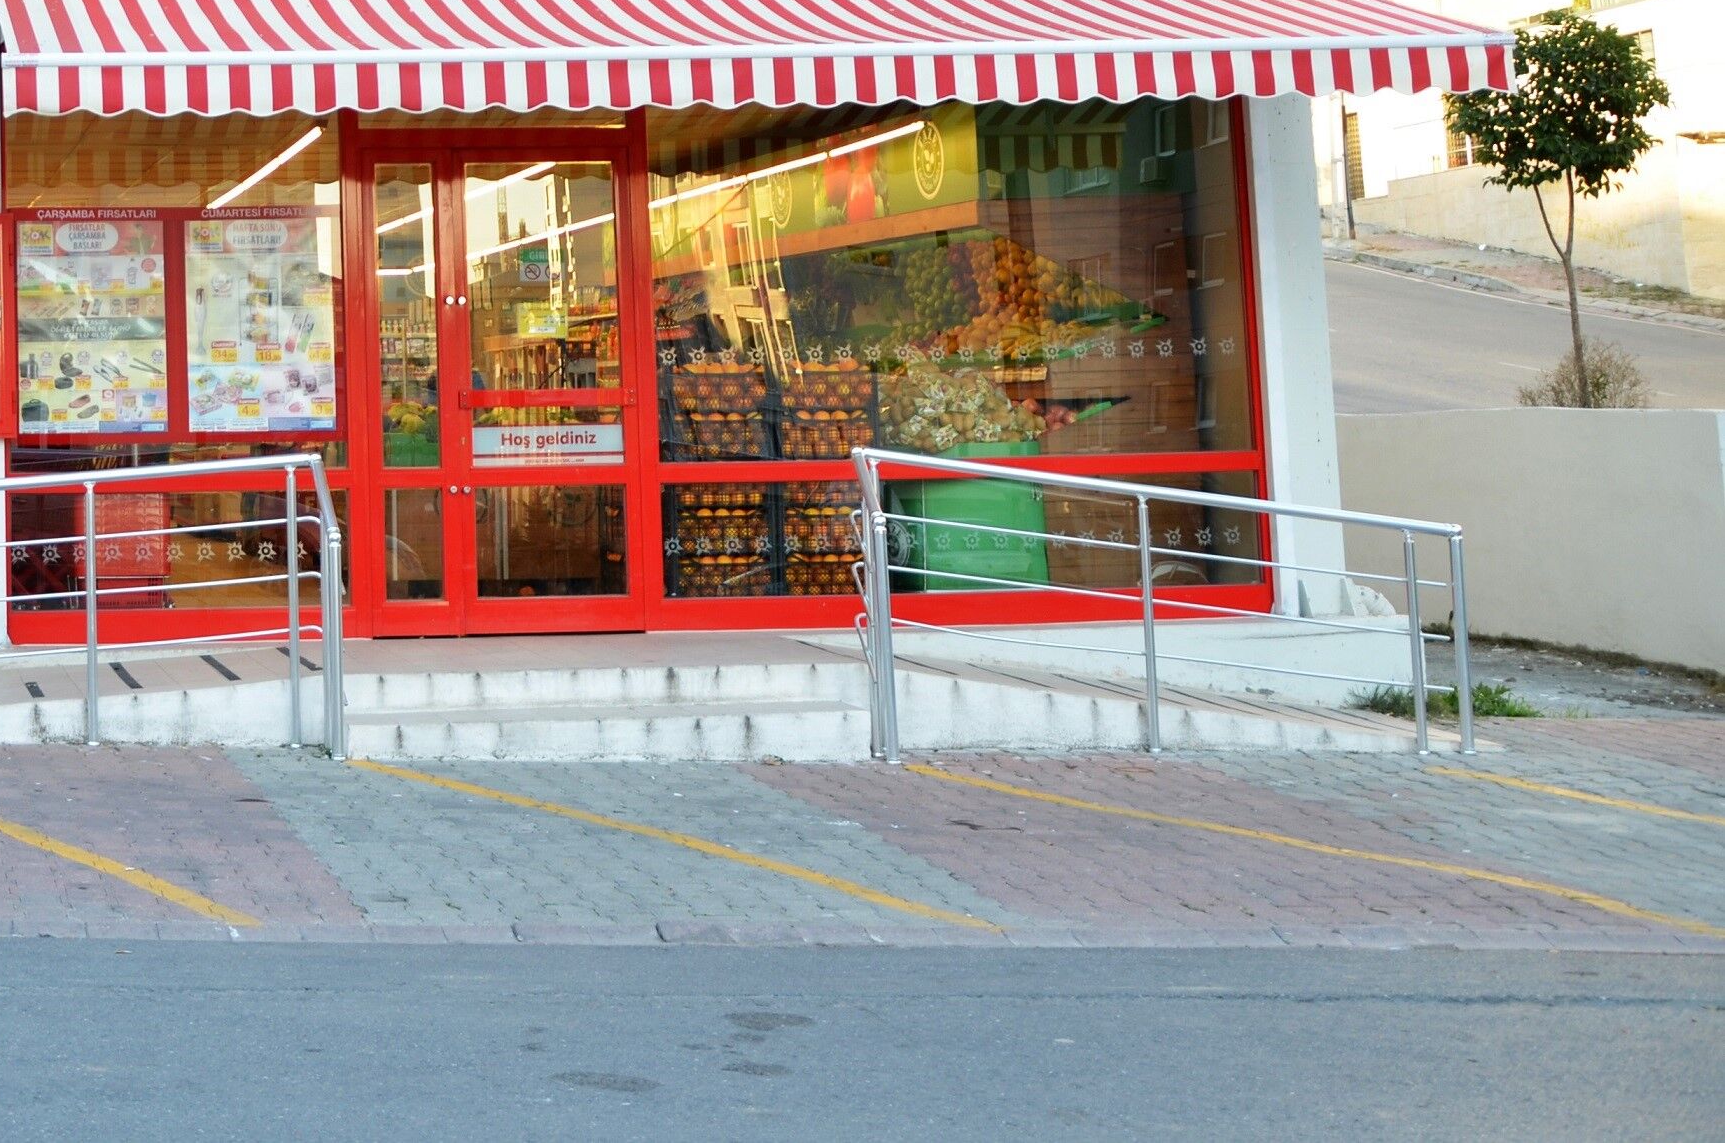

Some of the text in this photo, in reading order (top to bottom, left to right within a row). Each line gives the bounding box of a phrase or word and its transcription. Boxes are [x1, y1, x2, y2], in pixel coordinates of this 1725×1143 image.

[37, 209, 157, 221] ÇARŞAMBA FIRSATLARI
[201, 206, 261, 219] CUMARTESİ
[500, 431, 598, 449] Hoş geldiniz
